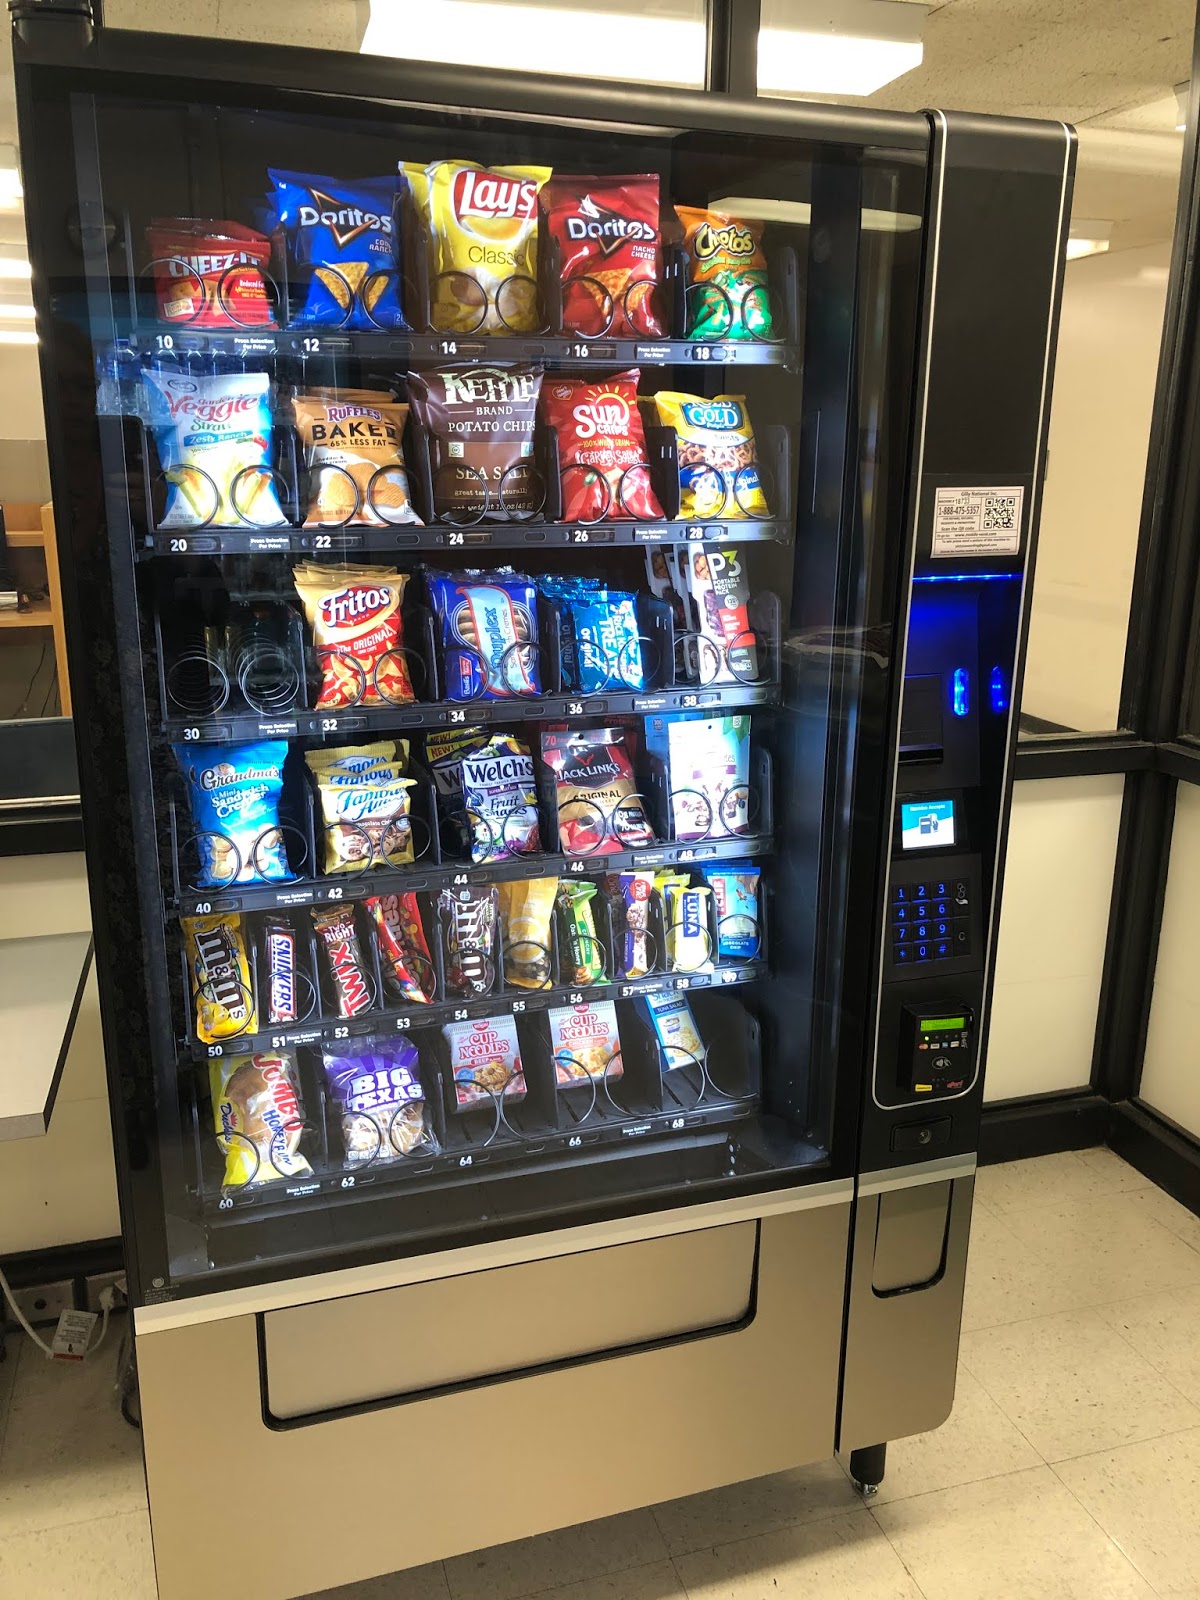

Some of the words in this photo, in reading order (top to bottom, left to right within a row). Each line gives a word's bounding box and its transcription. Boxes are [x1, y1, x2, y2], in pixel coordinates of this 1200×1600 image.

[459, 171, 537, 218] Lay's
[299, 207, 392, 232] Doritos
[568, 218, 656, 241] Doritos
[468, 246, 525, 266] Classic
[631, 252, 656, 260] CHEESE
[632, 246, 656, 254] NACHO
[169, 252, 261, 277] CHEEZ-IT
[156, 335, 173, 349] 10
[303, 338, 319, 352] 12
[442, 342, 457, 354] 14
[574, 345, 588, 357] 16
[696, 346, 710, 360] 18
[164, 391, 258, 422] Veggie
[476, 406, 513, 416] BRAND
[327, 406, 382, 422] RUFFLES
[689, 408, 738, 427] GOLD
[448, 421, 500, 432] POTATO
[503, 420, 536, 432] CHIPS
[189, 435, 215, 444] Zesty
[217, 432, 247, 441] Ranch
[456, 466, 489, 480] SEA
[938, 506, 979, 515] 1-888-475-5357
[449, 533, 464, 545] 24
[574, 530, 588, 542] 26
[689, 528, 703, 539] 28
[170, 539, 187, 552] 20
[315, 535, 331, 548] 22
[706, 550, 742, 580] P3
[713, 577, 740, 587] PORTABLE
[714, 583, 738, 591] PROTEIN
[318, 588, 390, 627] Fritos
[613, 615, 624, 636] RICE
[353, 628, 393, 650] ORIGINAL
[599, 616, 619, 678] TREATS
[684, 696, 696, 706] 38
[569, 703, 583, 714] 36
[451, 711, 465, 722] 34
[322, 719, 337, 731] 32
[184, 728, 200, 740] 30
[545, 736, 556, 745] 70
[431, 745, 454, 759] NEW!
[465, 760, 534, 783] Welch's
[558, 768, 587, 781] JACK
[201, 767, 279, 790] Grandma's
[219, 788, 236, 798] Mini
[216, 792, 266, 818] Crees
[491, 796, 519, 809] Fruit
[571, 861, 584, 872] 46
[454, 874, 468, 885] 44
[328, 888, 343, 899] 42
[898, 889, 904, 898] 1
[918, 886, 924, 896] 2
[938, 884, 944, 893] 3
[196, 902, 211, 914] 40
[898, 909, 905, 918] 4
[919, 906, 925, 916] 5
[939, 904, 945, 913] 6
[687, 895, 700, 934] LUNA
[324, 925, 355, 944] RIGHT
[900, 929, 905, 938] 7
[919, 926, 926, 936] 8
[939, 924, 946, 934] 9
[958, 932, 966, 941] C
[920, 946, 926, 956] 0
[275, 939, 292, 1012] SNICKERS
[677, 978, 689, 989] 58
[622, 987, 634, 996] 57
[570, 993, 583, 1004] 56
[513, 1001, 525, 1012] 55
[455, 1010, 468, 1020] 54
[570, 1013, 598, 1028] CUP
[397, 1018, 410, 1029] 53
[335, 1027, 349, 1038] 52
[560, 1022, 609, 1041] NOODLES
[272, 1036, 285, 1048] 51
[469, 1031, 498, 1045] CUP
[208, 1045, 223, 1057] 50
[458, 1040, 510, 1060] NOODLES
[350, 1067, 412, 1094] BIG
[251, 1054, 303, 1132] JUMBO
[349, 1084, 423, 1112] TEXAS
[672, 1118, 684, 1128] 68
[569, 1136, 581, 1146] 66
[459, 1156, 472, 1166] 64
[341, 1176, 355, 1188] 62
[219, 1198, 233, 1209] 60
